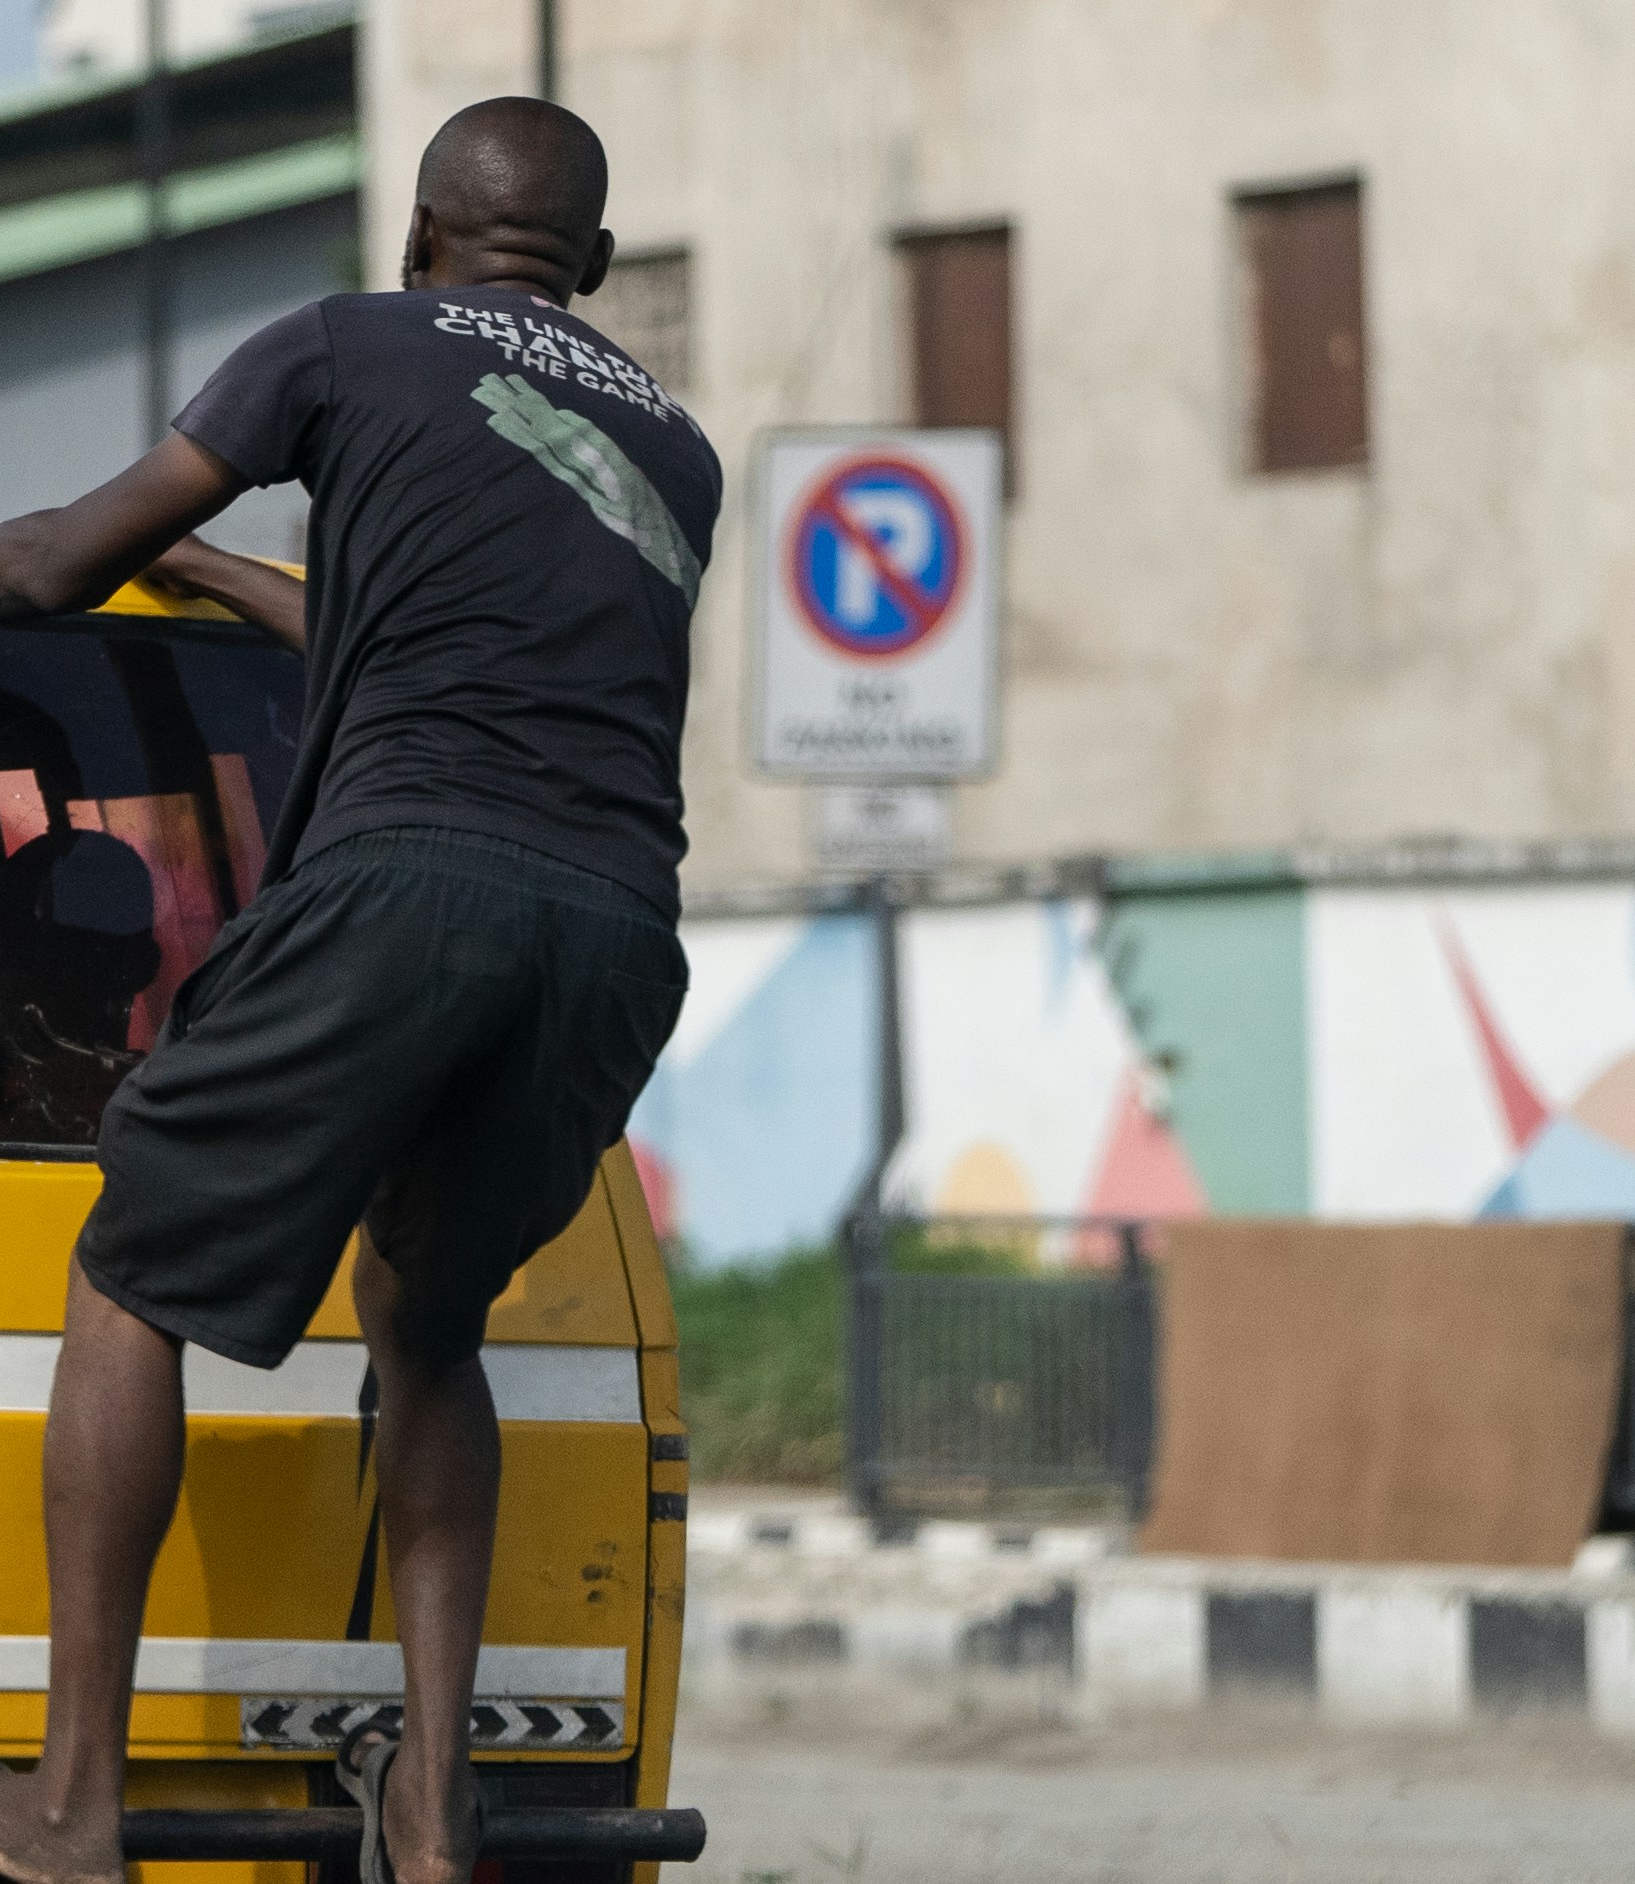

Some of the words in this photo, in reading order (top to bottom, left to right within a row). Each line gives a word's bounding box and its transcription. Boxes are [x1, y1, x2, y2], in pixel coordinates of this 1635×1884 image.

[438, 302, 516, 327] THE
[524, 317, 600, 358] LINE
[496, 341, 568, 380] THE
[576, 371, 669, 423] GAME
